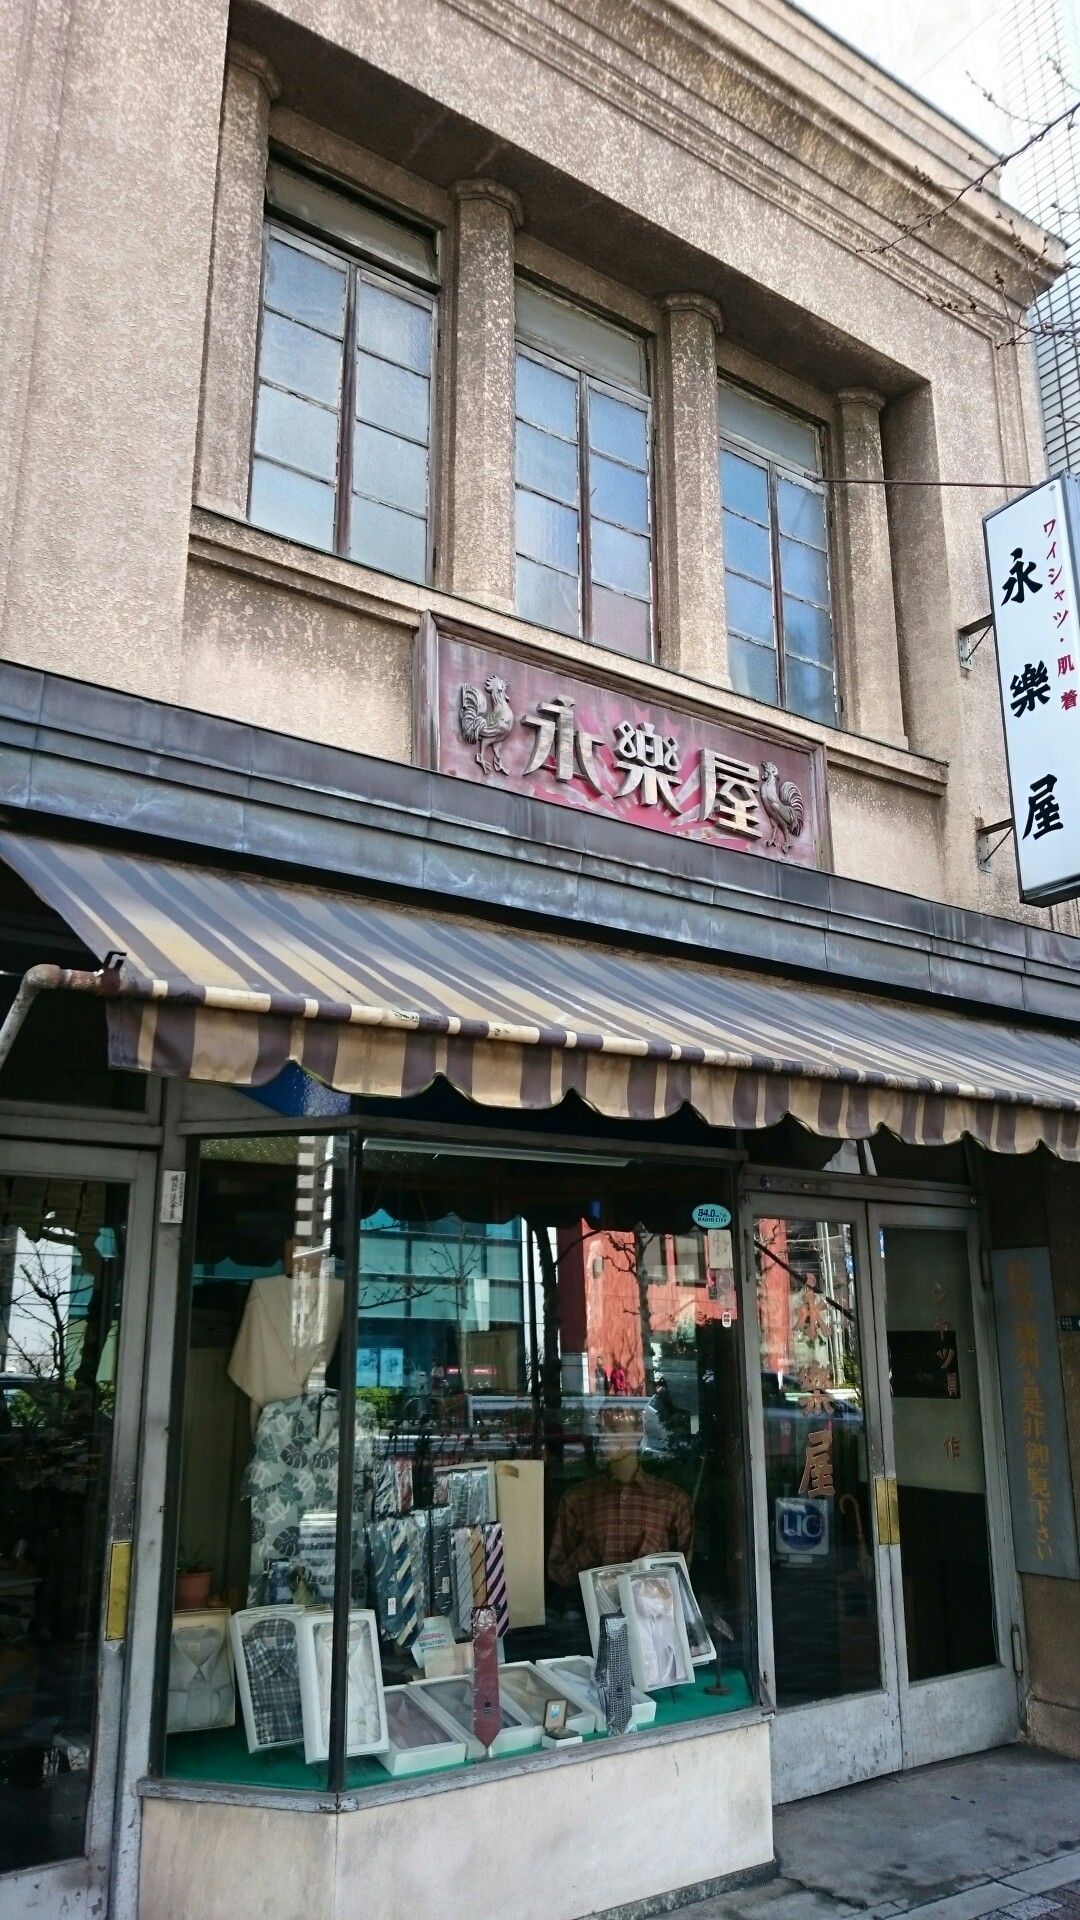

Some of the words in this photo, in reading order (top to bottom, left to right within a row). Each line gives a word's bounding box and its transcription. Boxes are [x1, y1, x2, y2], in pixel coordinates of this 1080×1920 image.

[1001, 547, 1064, 841] 永樂屋
[1043, 519, 1078, 710] ワイシャツ・肌着
[520, 693, 763, 840] 永樂屋
